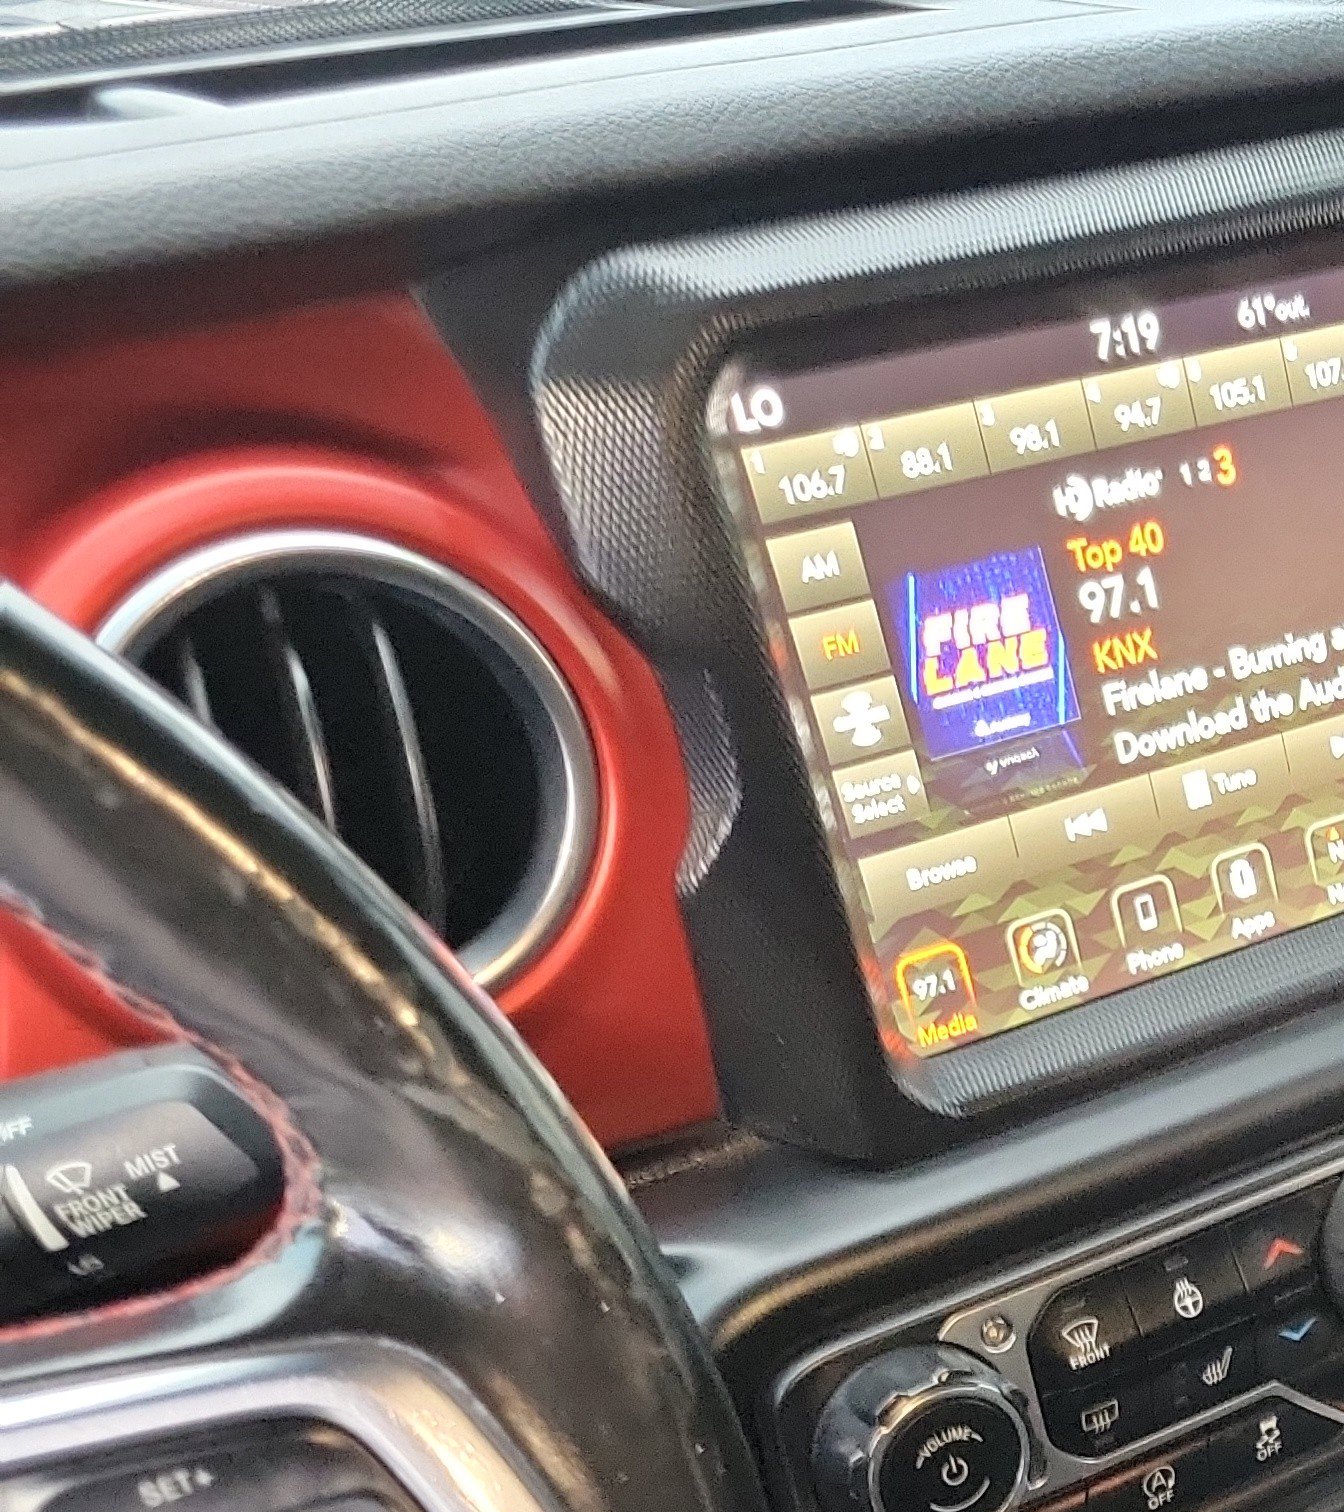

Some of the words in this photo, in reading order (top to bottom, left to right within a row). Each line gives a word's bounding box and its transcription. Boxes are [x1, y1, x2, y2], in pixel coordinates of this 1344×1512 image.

[1090, 312, 1160, 361] 7:19
[731, 387, 784, 433] LO
[1209, 375, 1266, 411] 105.1
[1114, 396, 1162, 432] 94.7
[1009, 419, 1060, 455] 98.1
[900, 442, 954, 479] 88.1
[1213, 444, 1238, 487] 3
[778, 465, 846, 505] 106.7
[1067, 536, 1122, 572] Top
[1128, 522, 1164, 554] 40
[802, 550, 840, 583] AM
[1079, 567, 1159, 624] 97.1
[923, 593, 1031, 657] FIRE
[822, 629, 860, 662] FM
[923, 628, 1049, 696] LANE
[1092, 627, 1158, 673] KNX
[1102, 663, 1208, 716] Firelane
[1227, 630, 1327, 681] Burning
[1113, 705, 1248, 764] Download
[1251, 690, 1293, 722] the
[906, 856, 978, 891] Browse
[1125, 943, 1184, 975] Phone
[913, 968, 956, 1000] 97.1
[1019, 975, 1090, 1010] Climate
[917, 1012, 978, 1047] Media
[123, 1142, 181, 1181] MIST
[53, 1182, 128, 1225] FRONT
[68, 1200, 148, 1239] WIPER
[1069, 1342, 1111, 1371] FRONT
[919, 1426, 972, 1460] VOLUME
[1256, 1442, 1283, 1463] OFF
[1147, 1489, 1175, 1511] OFF
